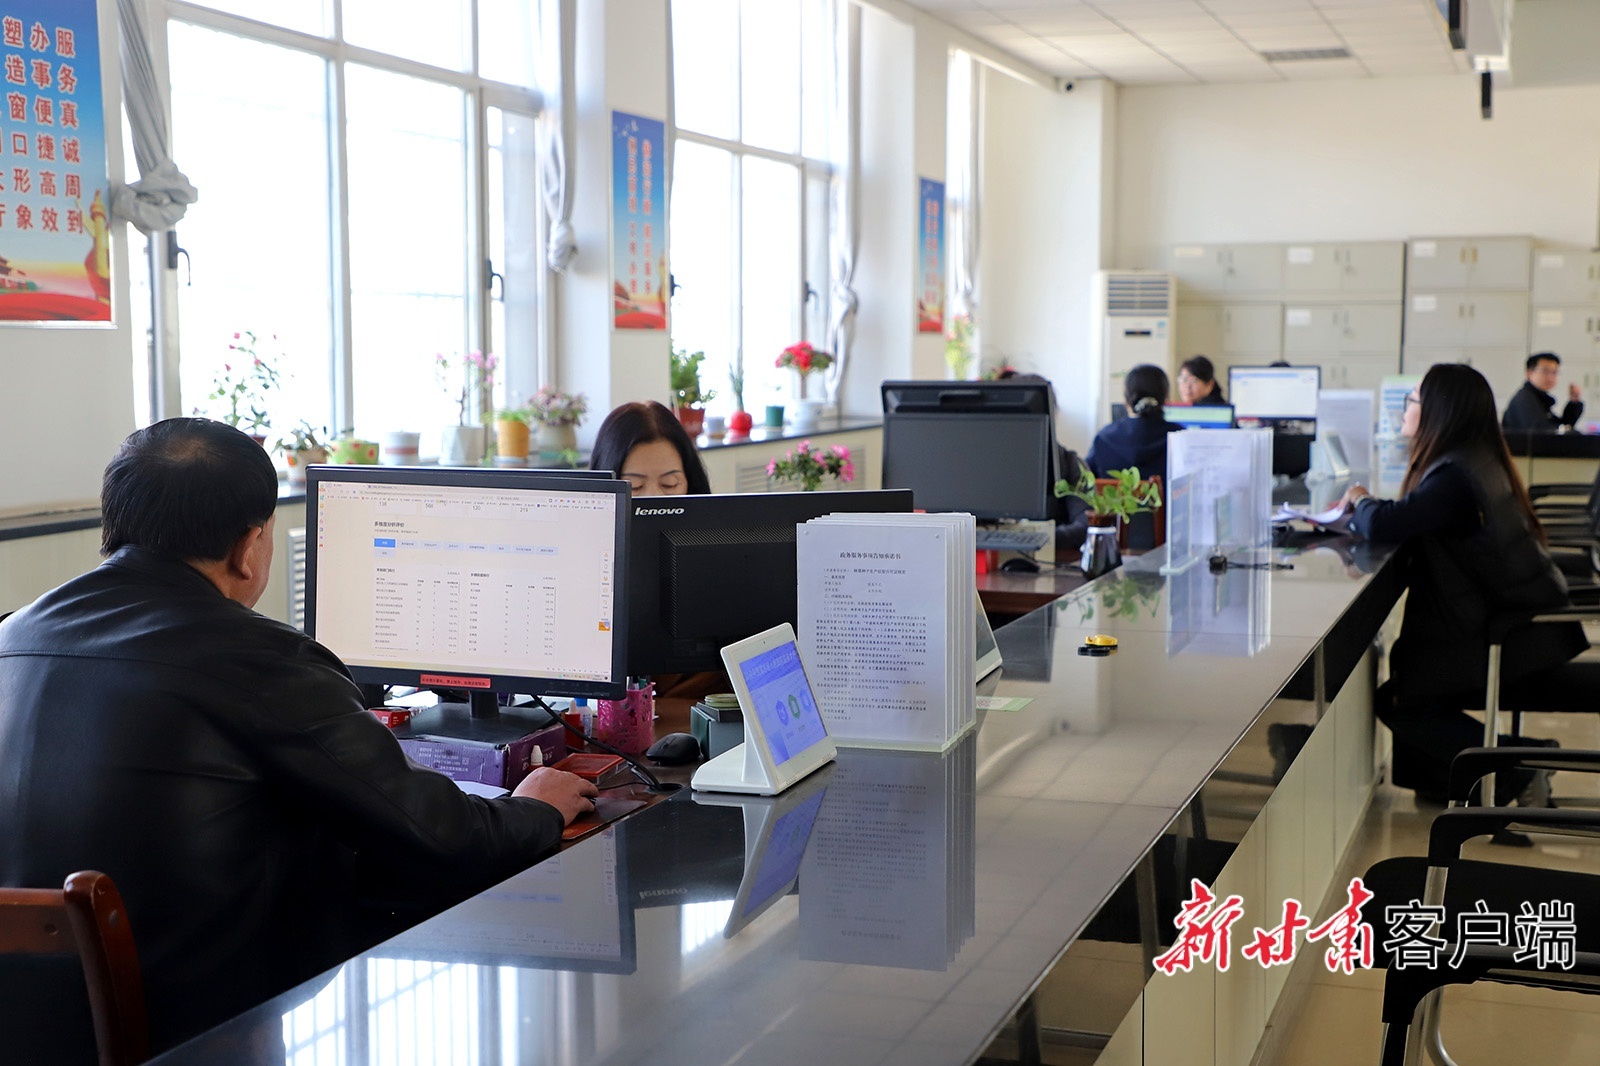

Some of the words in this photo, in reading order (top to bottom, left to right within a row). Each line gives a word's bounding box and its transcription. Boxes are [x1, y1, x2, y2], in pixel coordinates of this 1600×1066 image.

[4, 17, 33, 230] 塑造窗口形象
[31, 23, 59, 232] 办事便捷高效
[56, 27, 83, 234] 服务真诚周到
[635, 507, 685, 516] lenovo
[839, 552, 902, 560] 政务服务事项告知承诺书
